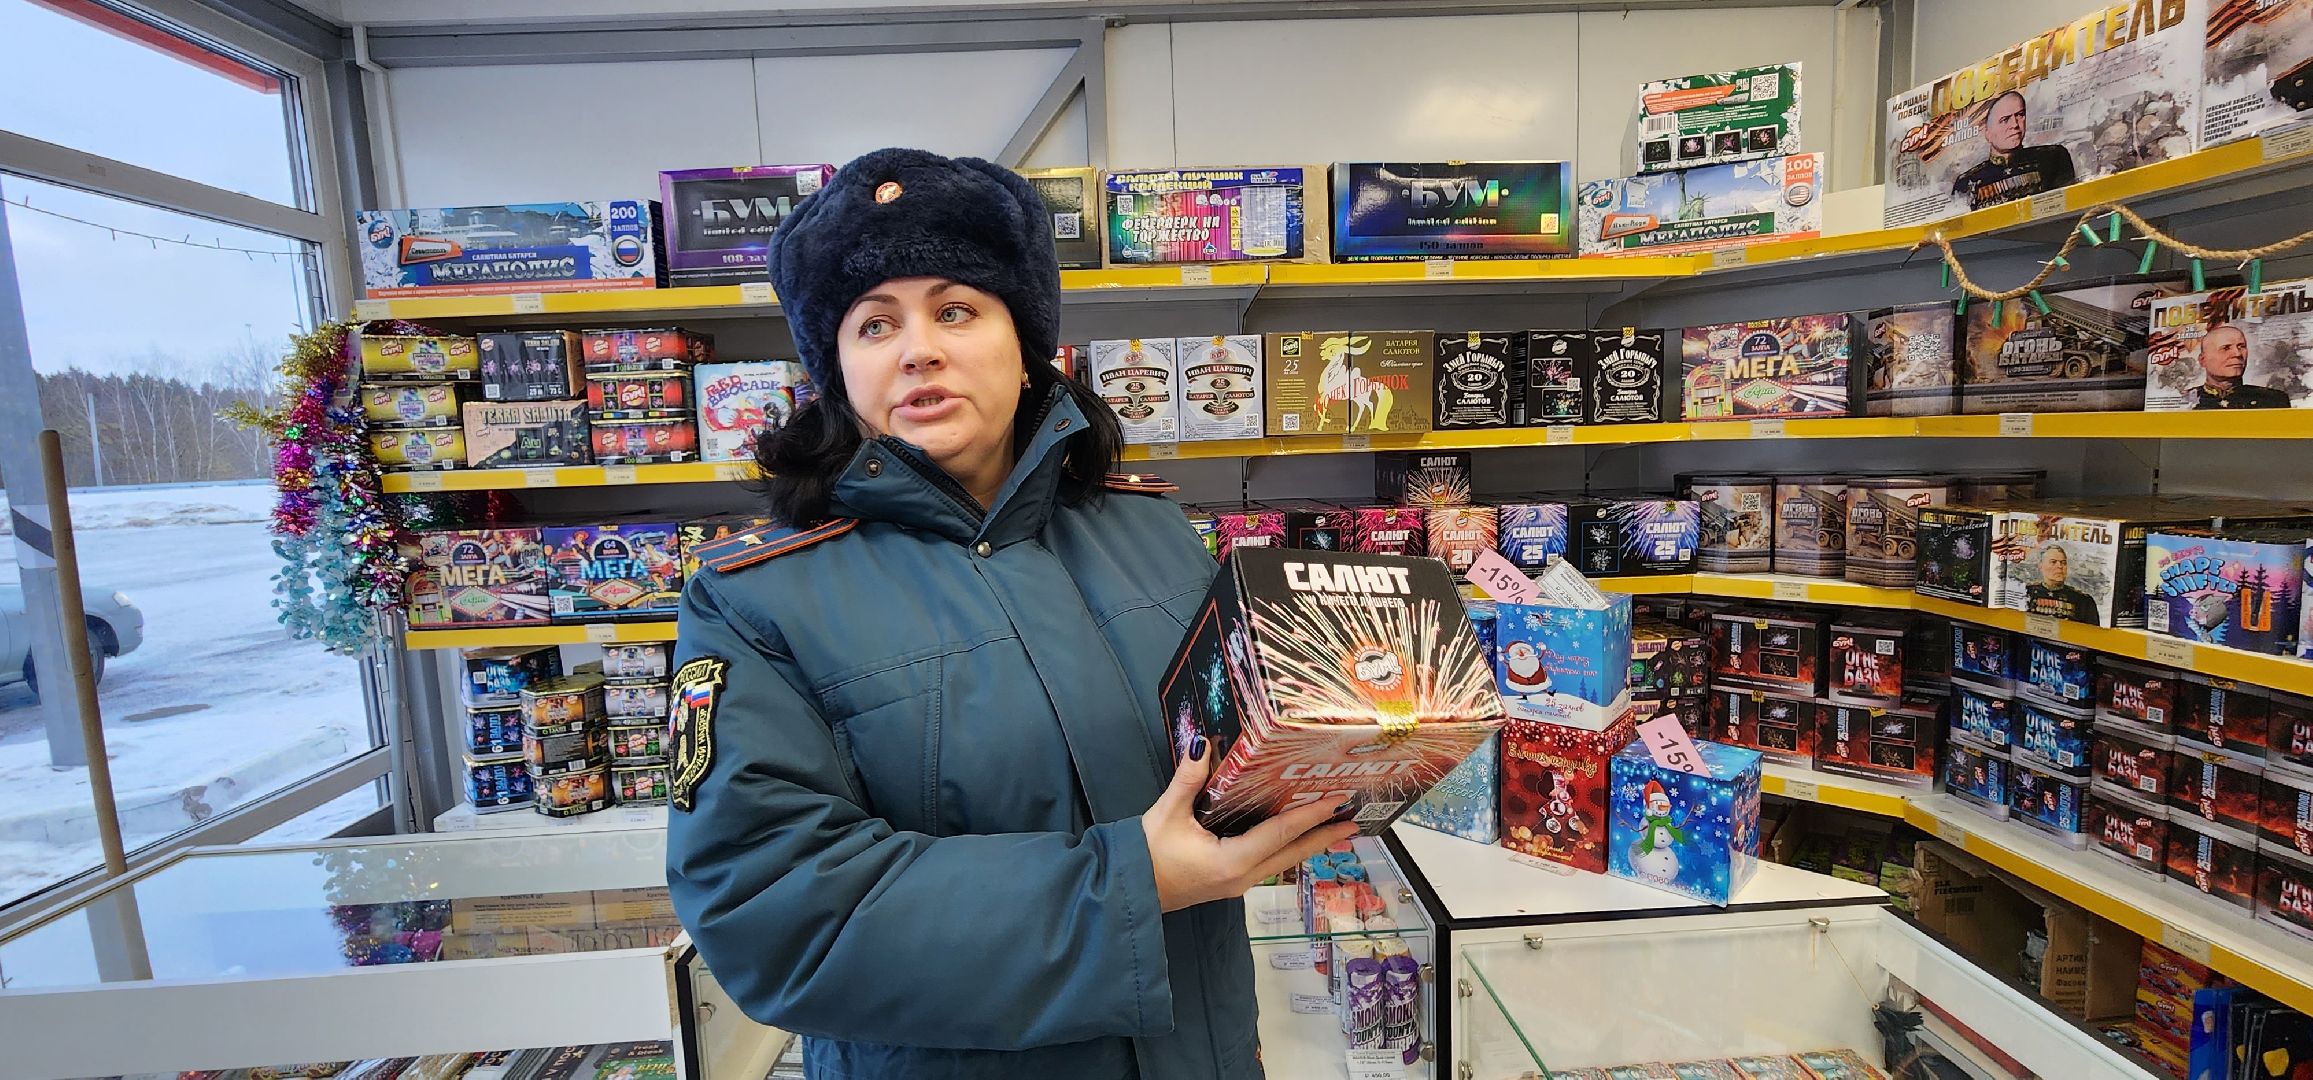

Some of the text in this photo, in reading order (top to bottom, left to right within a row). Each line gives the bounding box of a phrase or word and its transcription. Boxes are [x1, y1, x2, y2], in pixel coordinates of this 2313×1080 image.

[1932, 0, 2187, 118] ПОБЕДИТЕЛЬ
[1892, 91, 1929, 113] МАРШАЛЫ
[1898, 102, 1928, 120] ПОБЕДЫ
[1787, 159, 1813, 173] 100
[1411, 180, 1499, 208] БУМ
[611, 205, 636, 219] 200
[701, 197, 791, 223] БУМ
[1121, 215, 1220, 232] ФЕЙЕРВЕРК НА
[1639, 219, 1760, 245] МЕГАПОЛИС
[1133, 229, 1210, 243] ТОРЖЕСТВО
[430, 258, 576, 282] МЕГАПОЛИС
[1386, 339, 1418, 347] БАТАРЕЯ
[1754, 336, 1767, 345] 72
[2003, 337, 2063, 355] ОГОНЬ
[1188, 365, 1252, 377] ИВАН ЦАРЕВИЧ
[1284, 360, 1299, 372] 25
[1620, 370, 1636, 379] 20
[1725, 355, 1800, 380] МЕГА
[1102, 368, 1167, 383] ИВАН ЦАРЕВИЧ
[1216, 378, 1226, 387] 25
[1467, 373, 1483, 382] 20
[705, 374, 741, 398] RED
[708, 380, 781, 407] BROCADE
[1130, 381, 1141, 390] 25
[1457, 397, 1491, 405] САЛЮТОВ
[1610, 394, 1643, 402] САЛЮТОВ
[480, 407, 572, 425] TERRA SALUTA
[1420, 456, 1458, 467] САЛЮТ
[1782, 503, 1817, 513] ОГОНЬ
[1371, 530, 1410, 541] САЛЮТ
[1443, 530, 1482, 541] САЛЮТ
[1512, 526, 1554, 539] САЛЮТ
[1646, 522, 1687, 534] САЛЮТ
[462, 544, 474, 554] 72
[603, 540, 617, 549] 64
[1231, 534, 1271, 547] САЛЮТ
[1654, 540, 1676, 556] 25
[1451, 549, 1473, 565] 20
[1521, 545, 1543, 560] 25
[440, 564, 507, 586] МЕГА
[581, 559, 649, 579] МЕГА
[2160, 557, 2225, 580] SHAPE
[1284, 562, 1411, 594] САЛЮТ
[1480, 566, 1527, 604] -15%
[2160, 574, 2239, 597] SHIFTER
[1361, 596, 1406, 608] ЛИШНЕГО
[1845, 650, 1879, 669] ОГНЕ
[2031, 647, 2062, 668] ОГНЕ
[1844, 665, 1881, 686] БАЗА
[2030, 661, 2063, 685] БАЗА
[2113, 682, 2145, 700] ОГНЕ
[1962, 696, 1989, 717] ОГНЕ
[2112, 694, 2146, 712] БАЗА
[1962, 709, 1991, 731] БАЗА
[2025, 713, 2056, 736] ОГНЕ
[2024, 727, 2058, 751] БАЗА
[2294, 723, 2313, 738] ОГ
[2292, 738, 2313, 755] БА
[2109, 749, 2138, 768] ОГНЕ
[1280, 759, 1420, 779] САЛЮТ
[2107, 761, 2139, 782] БАЗА
[2106, 815, 2135, 836] ОГНЕ
[2104, 827, 2138, 846] БАЗА
[2282, 879, 2313, 902] ОГН
[2280, 893, 2313, 917] БАЗ
